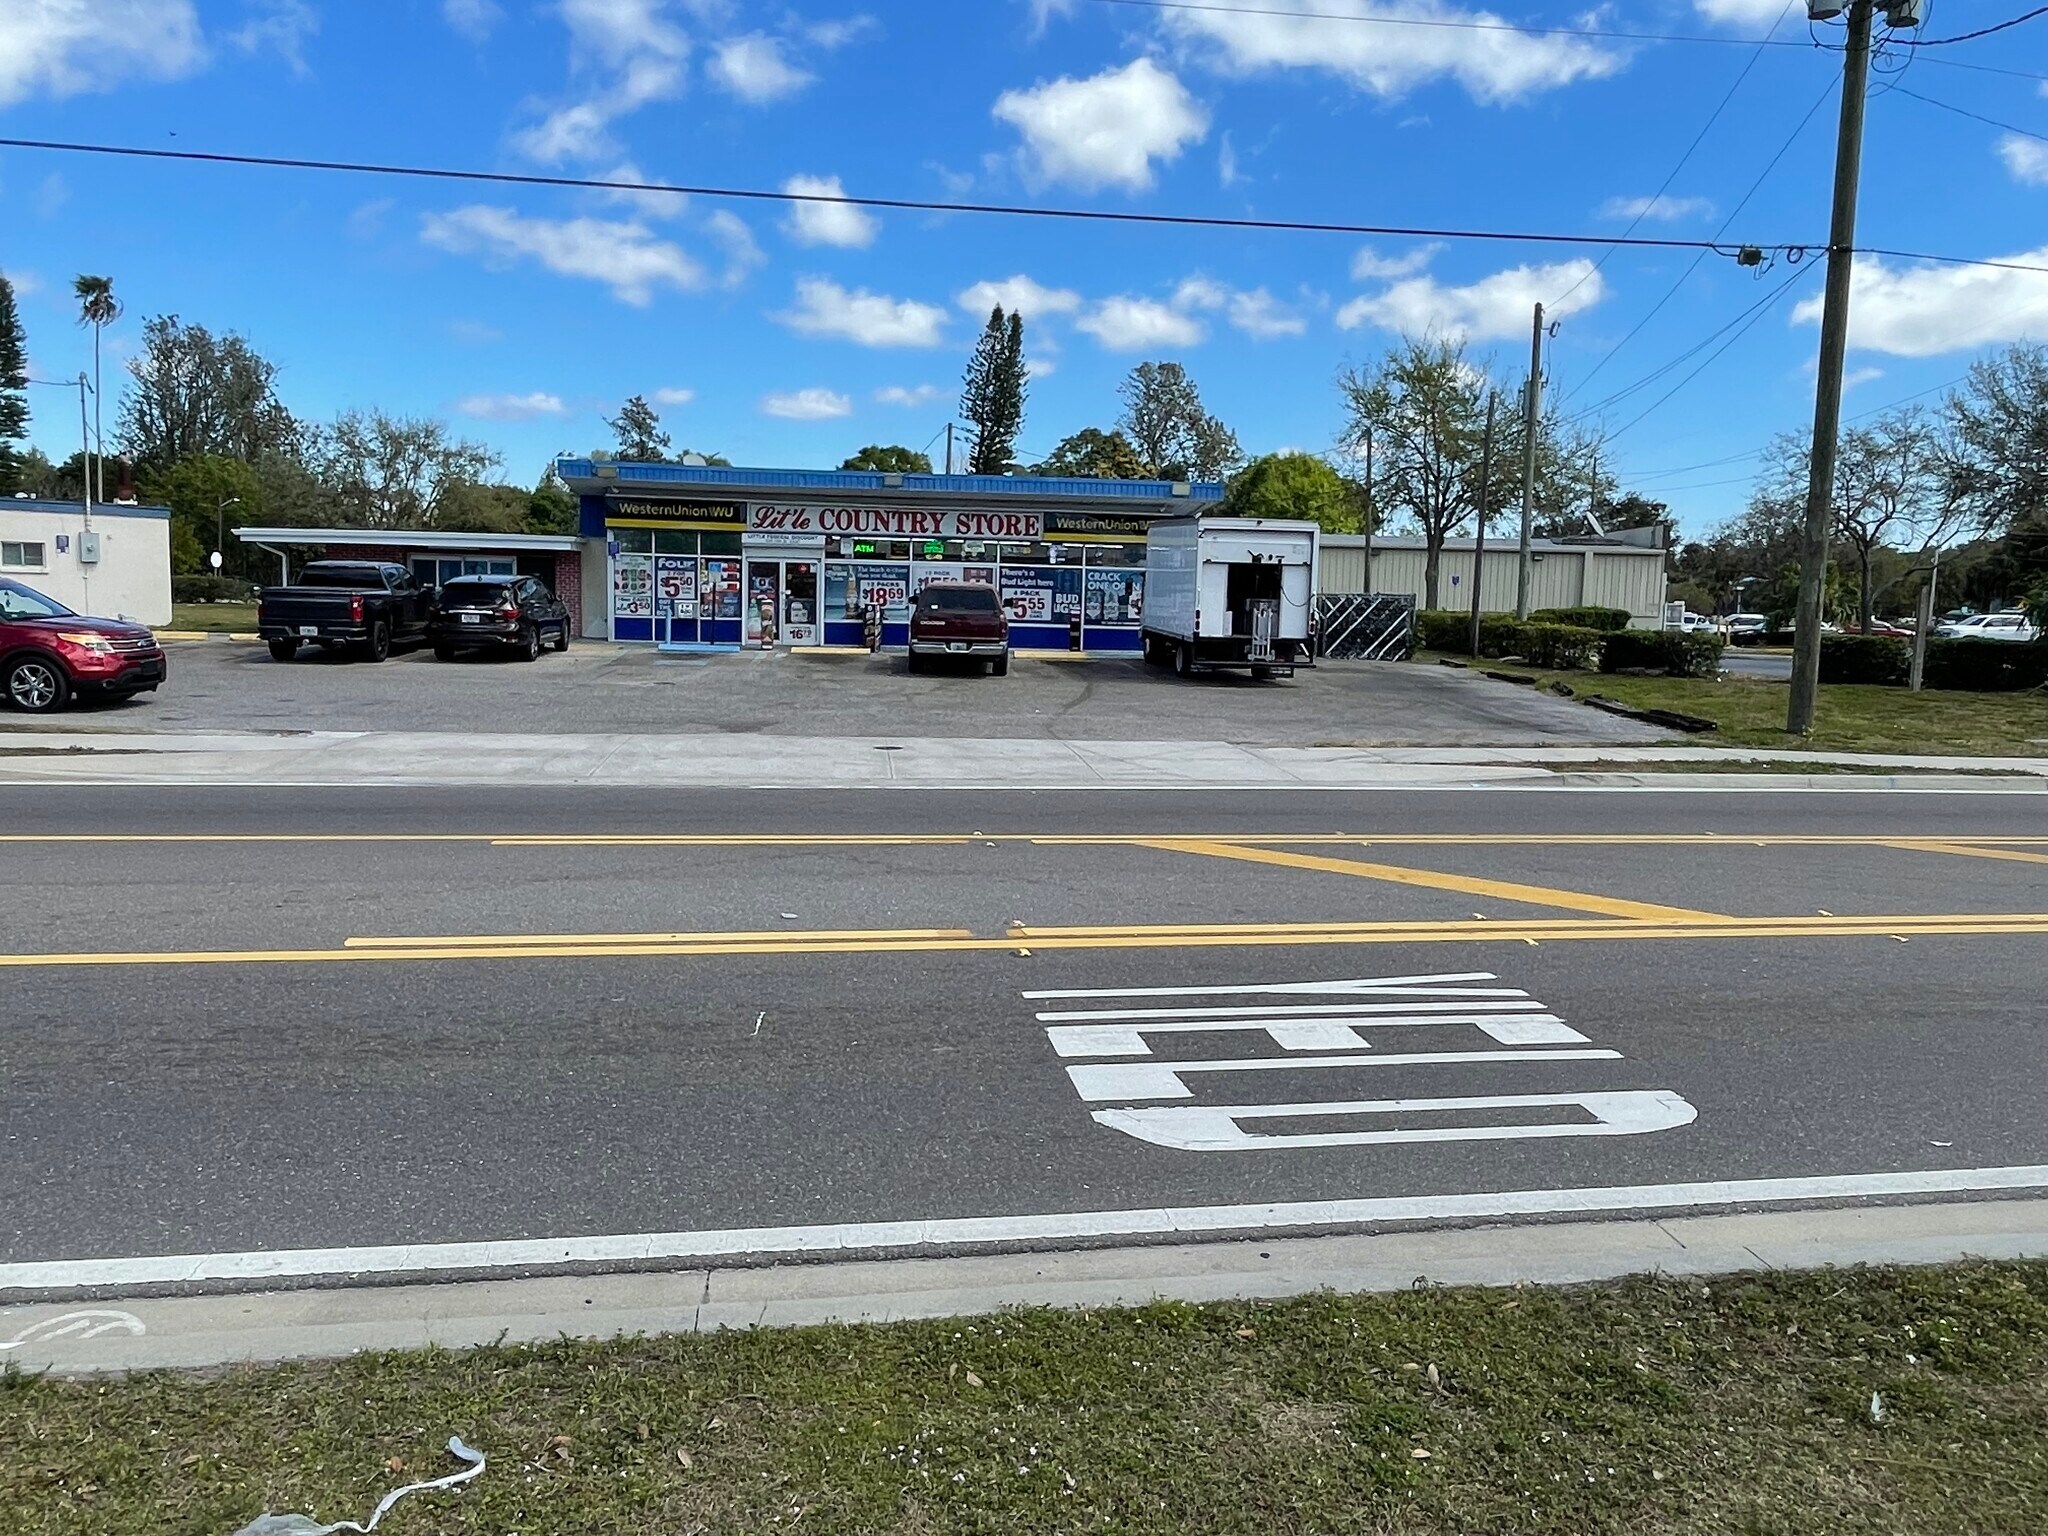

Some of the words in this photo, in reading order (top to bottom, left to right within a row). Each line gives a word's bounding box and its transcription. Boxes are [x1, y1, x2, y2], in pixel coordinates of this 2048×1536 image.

[818, 508, 949, 534] COUNTRY
[956, 512, 1040, 536] STORE
[855, 544, 875, 553] ATM
[1001, 568, 1028, 576] There's
[1088, 571, 1122, 582] CRACK
[1001, 577, 1017, 585] Bud
[1017, 577, 1037, 587] Light
[1037, 578, 1054, 587] here
[1087, 581, 1110, 590] ONE
[1112, 581, 1140, 591] OPN
[1055, 593, 1079, 603] BUD
